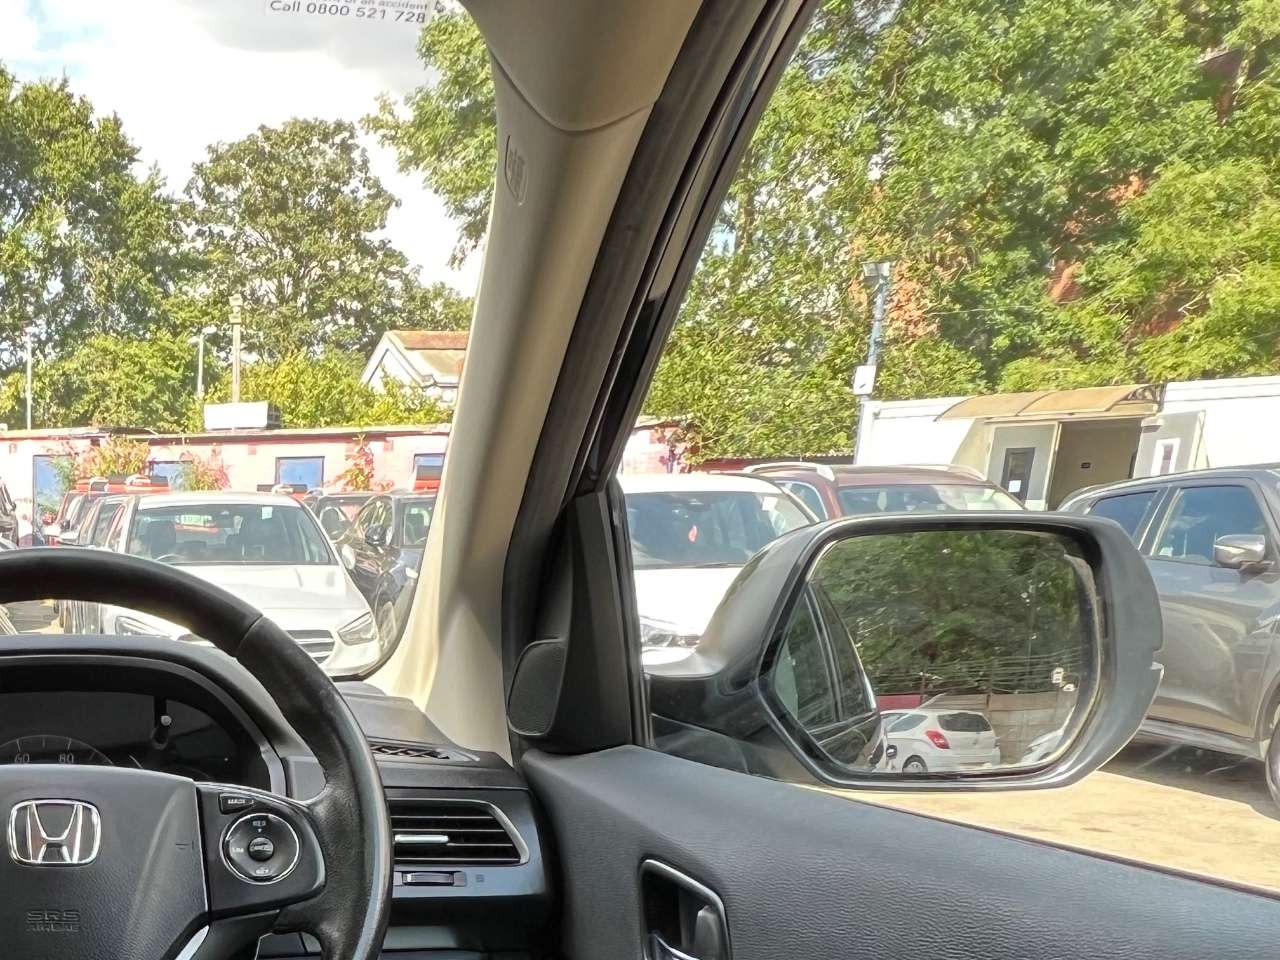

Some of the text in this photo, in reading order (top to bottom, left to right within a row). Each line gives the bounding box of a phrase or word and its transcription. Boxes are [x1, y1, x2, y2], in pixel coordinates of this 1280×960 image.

[378, 0, 428, 11] accident
[270, 0, 427, 24] Call 0800 521 728
[25, 909, 80, 921] SRS
